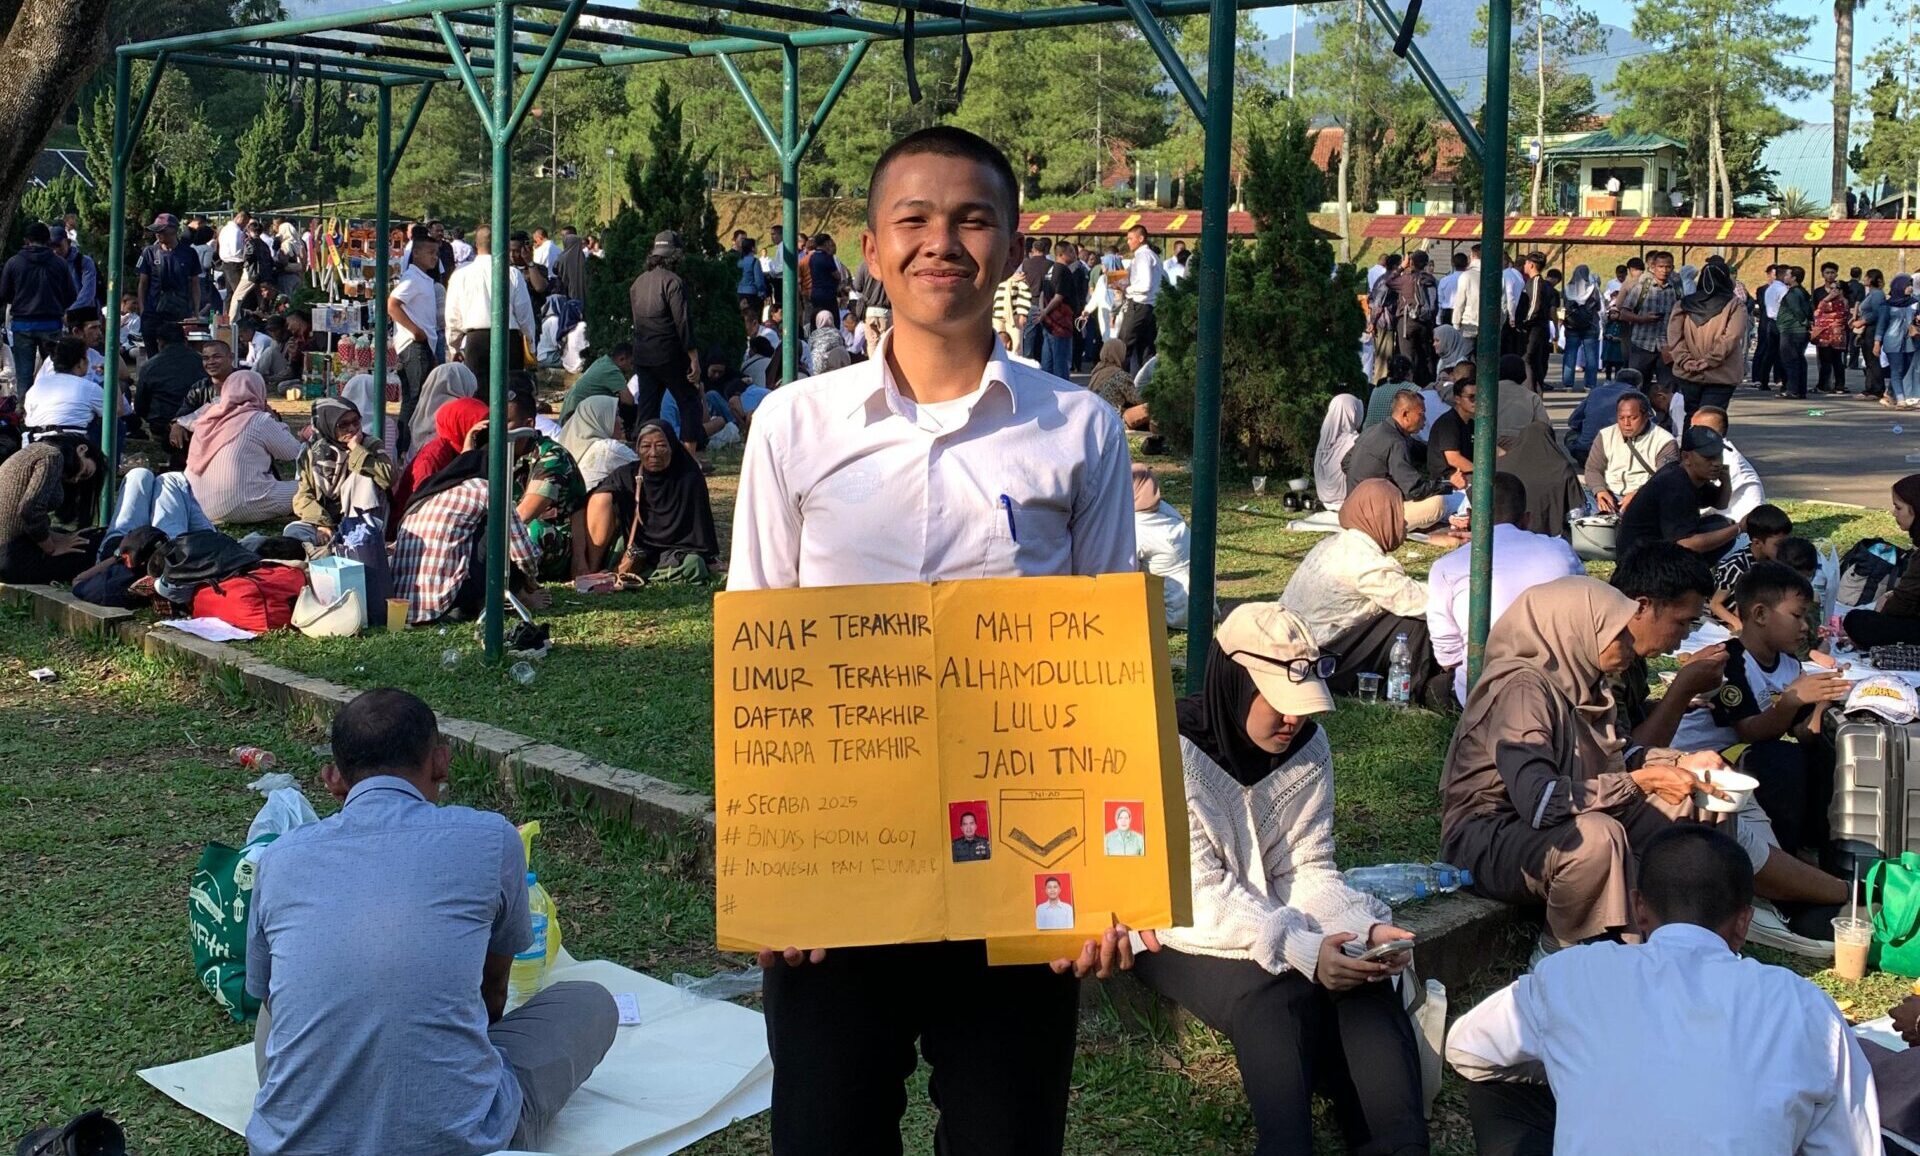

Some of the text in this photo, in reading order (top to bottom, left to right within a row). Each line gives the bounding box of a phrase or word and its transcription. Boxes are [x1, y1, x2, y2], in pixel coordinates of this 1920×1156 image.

[732, 612, 932, 651] ANAK TERAKHIR
[975, 611, 1104, 643] MAH PAK
[732, 663, 932, 692] UMUR TERAKHIR
[940, 656, 1145, 690] ALHAMDULLILAH
[734, 703, 929, 730] DAFTAR TERAKHIR
[993, 700, 1079, 733] LULUS
[734, 736, 921, 767] HARAPA TERAKHIR
[974, 746, 1127, 779] JADI TNI-AD
[818, 796, 858, 811] 2025
[813, 828, 869, 848] KODIM
